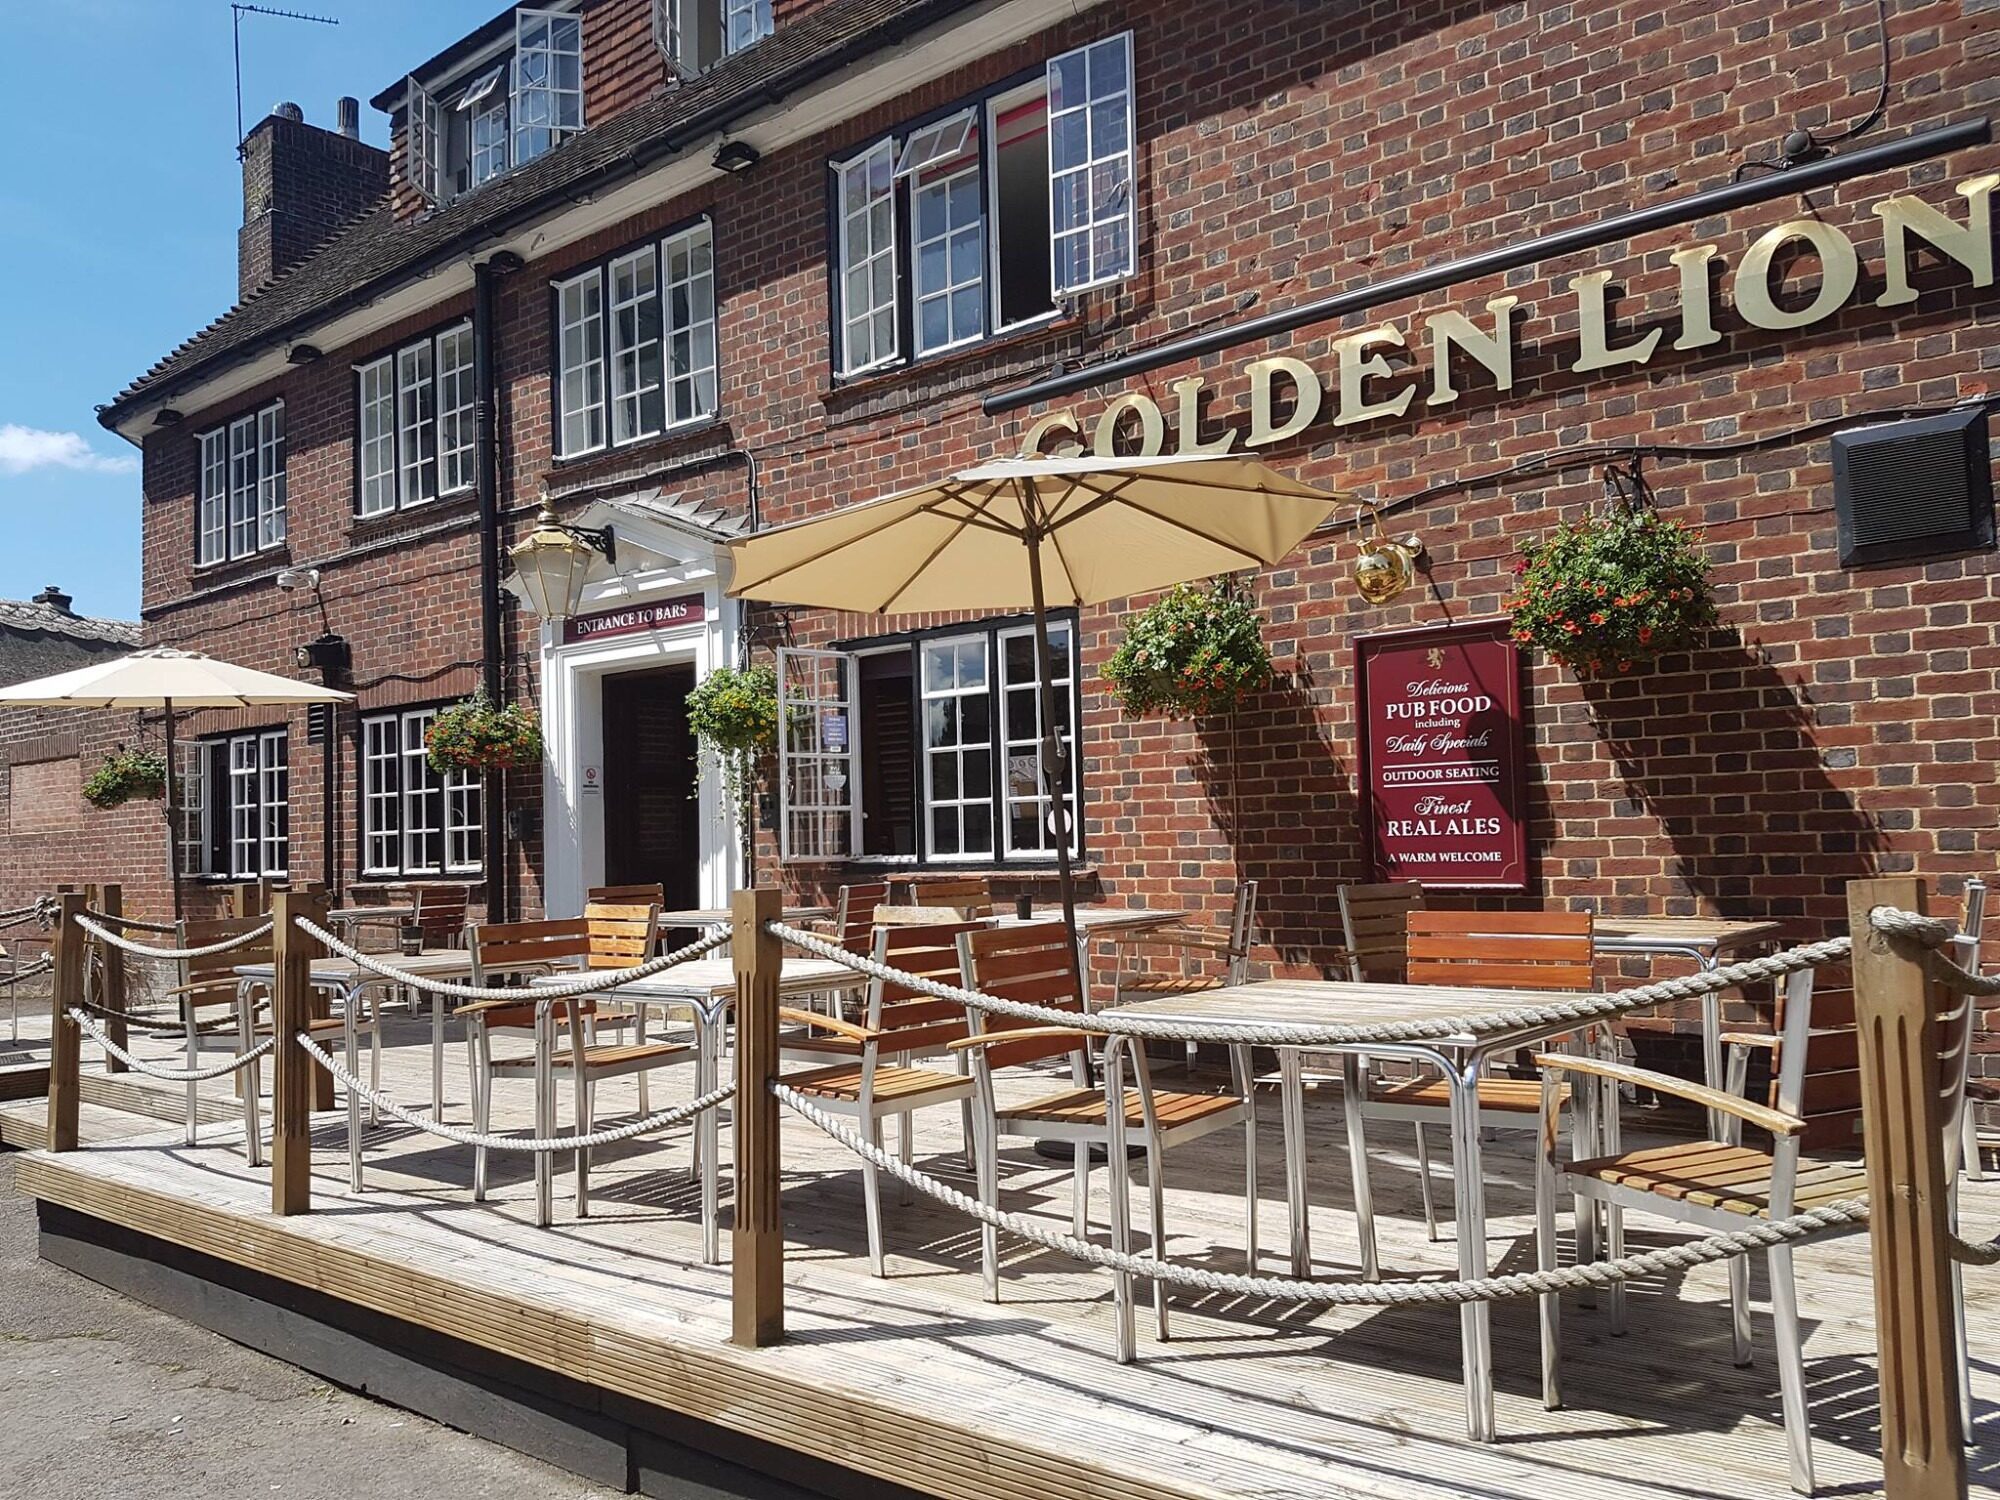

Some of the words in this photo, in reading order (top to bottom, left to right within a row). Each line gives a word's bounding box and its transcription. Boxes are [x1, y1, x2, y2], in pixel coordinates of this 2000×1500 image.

[1021, 300, 1517, 457] GOLDEN
[1569, 174, 2000, 373] LION
[577, 613, 634, 634] ENTRANCE
[637, 609, 653, 624] TO
[655, 603, 687, 621] BARS
[1406, 679, 1470, 697] Delicious
[1386, 701, 1426, 720] PUB
[1428, 695, 1492, 717] FOOD
[1415, 717, 1461, 729] including
[1385, 733, 1429, 757] Daily
[1430, 728, 1493, 755] Specials
[1382, 769, 1443, 782] OUTDOOR
[1445, 766, 1500, 779] SEATING
[1414, 795, 1473, 816] Finest
[1387, 819, 1442, 837] REAL
[1445, 817, 1501, 836] ALES
[1387, 853, 1397, 863] A
[1398, 852, 1437, 863] WARM
[1438, 851, 1502, 862] WELCOME
